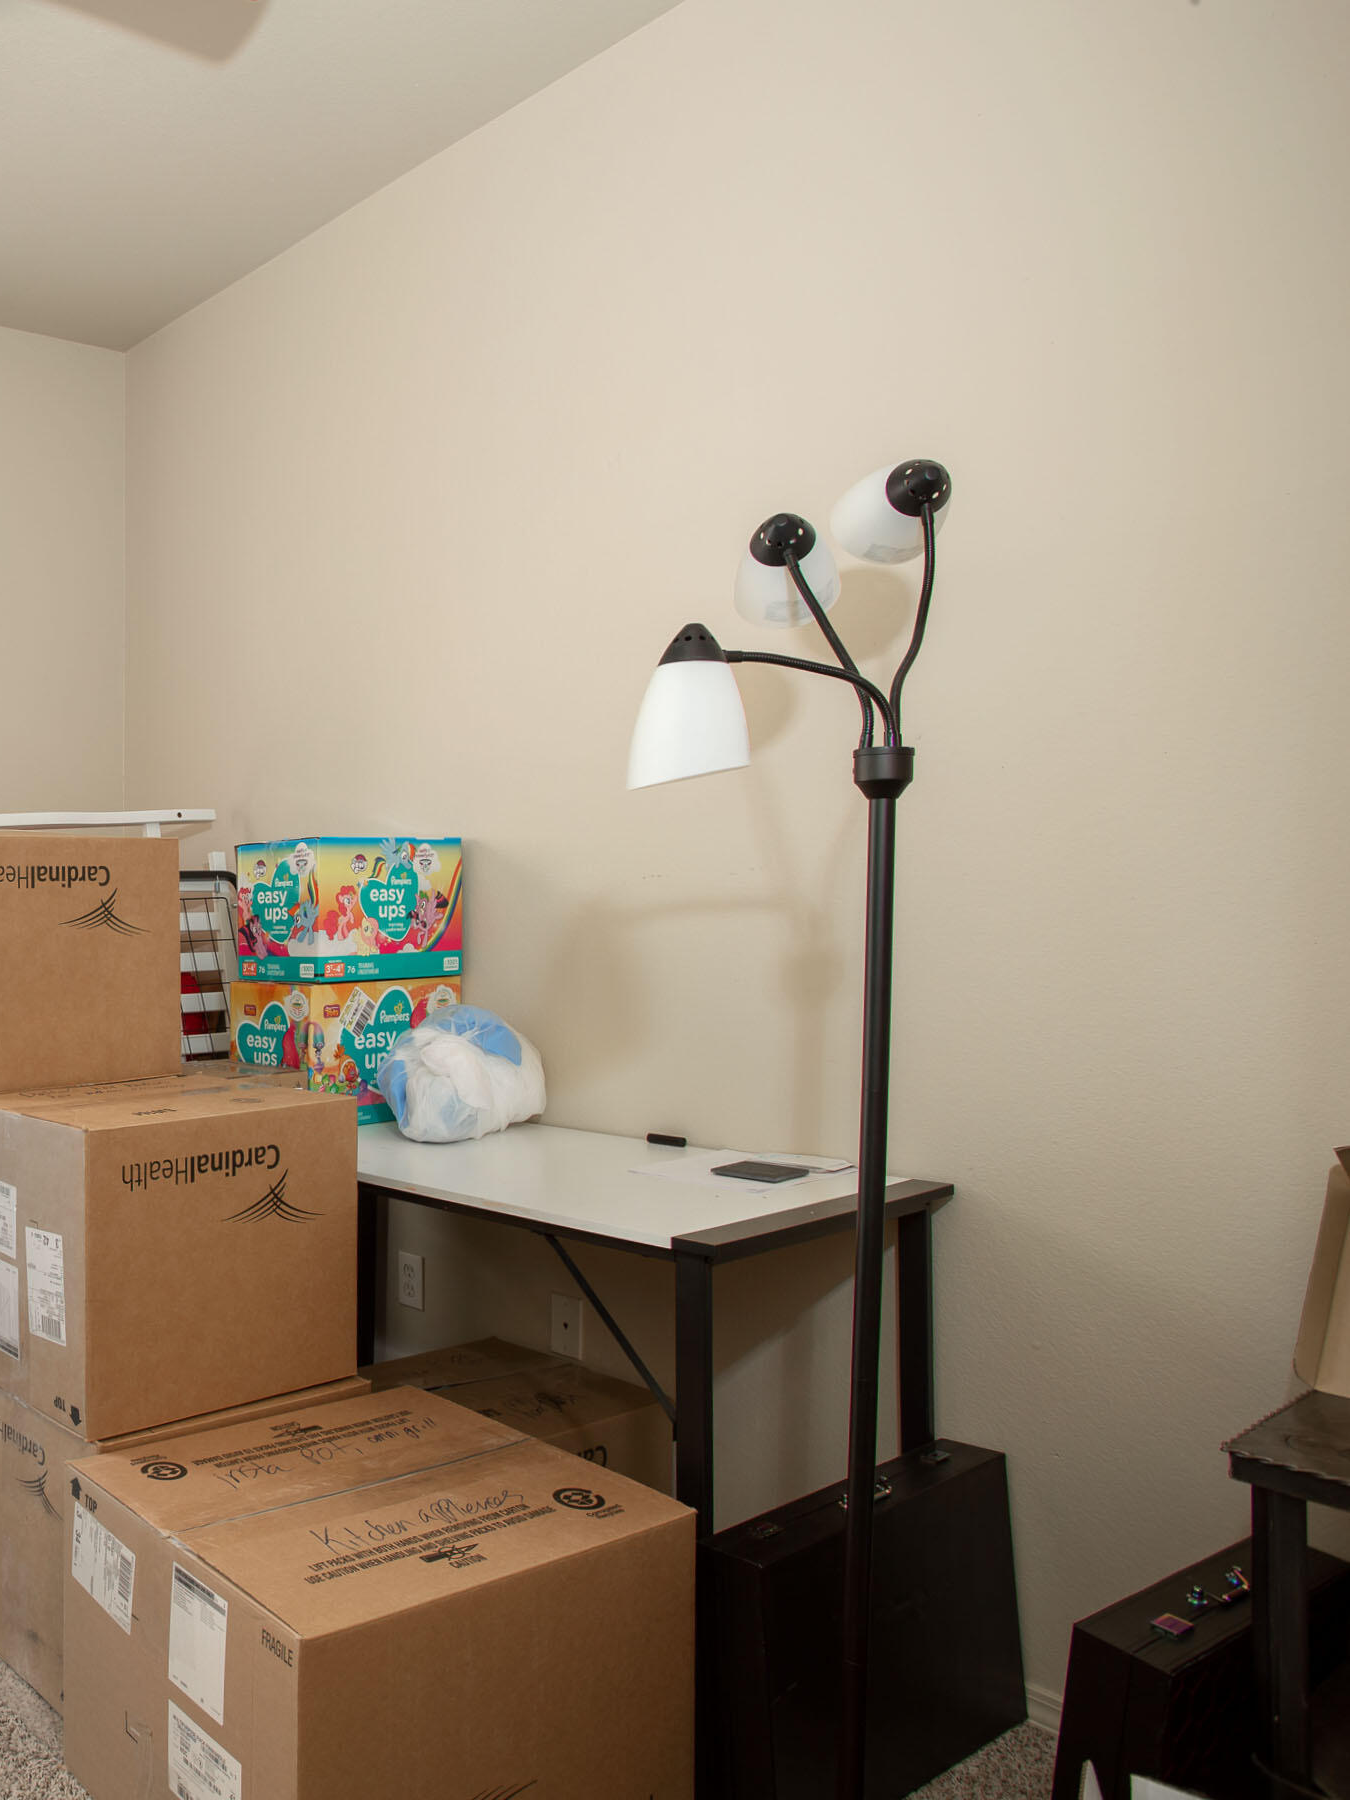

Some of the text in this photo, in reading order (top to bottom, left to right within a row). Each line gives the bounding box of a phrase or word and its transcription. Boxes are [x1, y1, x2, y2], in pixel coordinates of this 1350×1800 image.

[257, 889, 288, 906] easy
[369, 888, 405, 904] easy
[264, 907, 289, 923] ups
[378, 904, 406, 920] ups
[380, 1010, 410, 1024] Pampers
[246, 1034, 277, 1052] easy
[354, 1031, 397, 1051] easy
[253, 1051, 278, 1066] ups
[121, 1144, 282, 1192] CardinalHealth
[84, 1493, 98, 1513] TOP
[308, 1561, 330, 1572] LIFT
[327, 1554, 356, 1567] PACKS
[352, 1548, 377, 1560] WITH
[372, 1542, 398, 1554] BOTH
[393, 1535, 424, 1548] HANDS
[419, 1527, 446, 1540] WHEN
[499, 1503, 531, 1516] CARTON
[309, 1519, 419, 1556] Kitchen
[304, 1573, 326, 1585] USE
[322, 1564, 360, 1580] CAUTION
[356, 1557, 385, 1570] WHEN
[381, 1546, 423, 1564] HANDLING
[469, 1523, 498, 1536] PACKS
[493, 1520, 507, 1529] TO
[449, 1553, 488, 1569] CAUTION
[261, 1627, 295, 1668] FRAGILE
